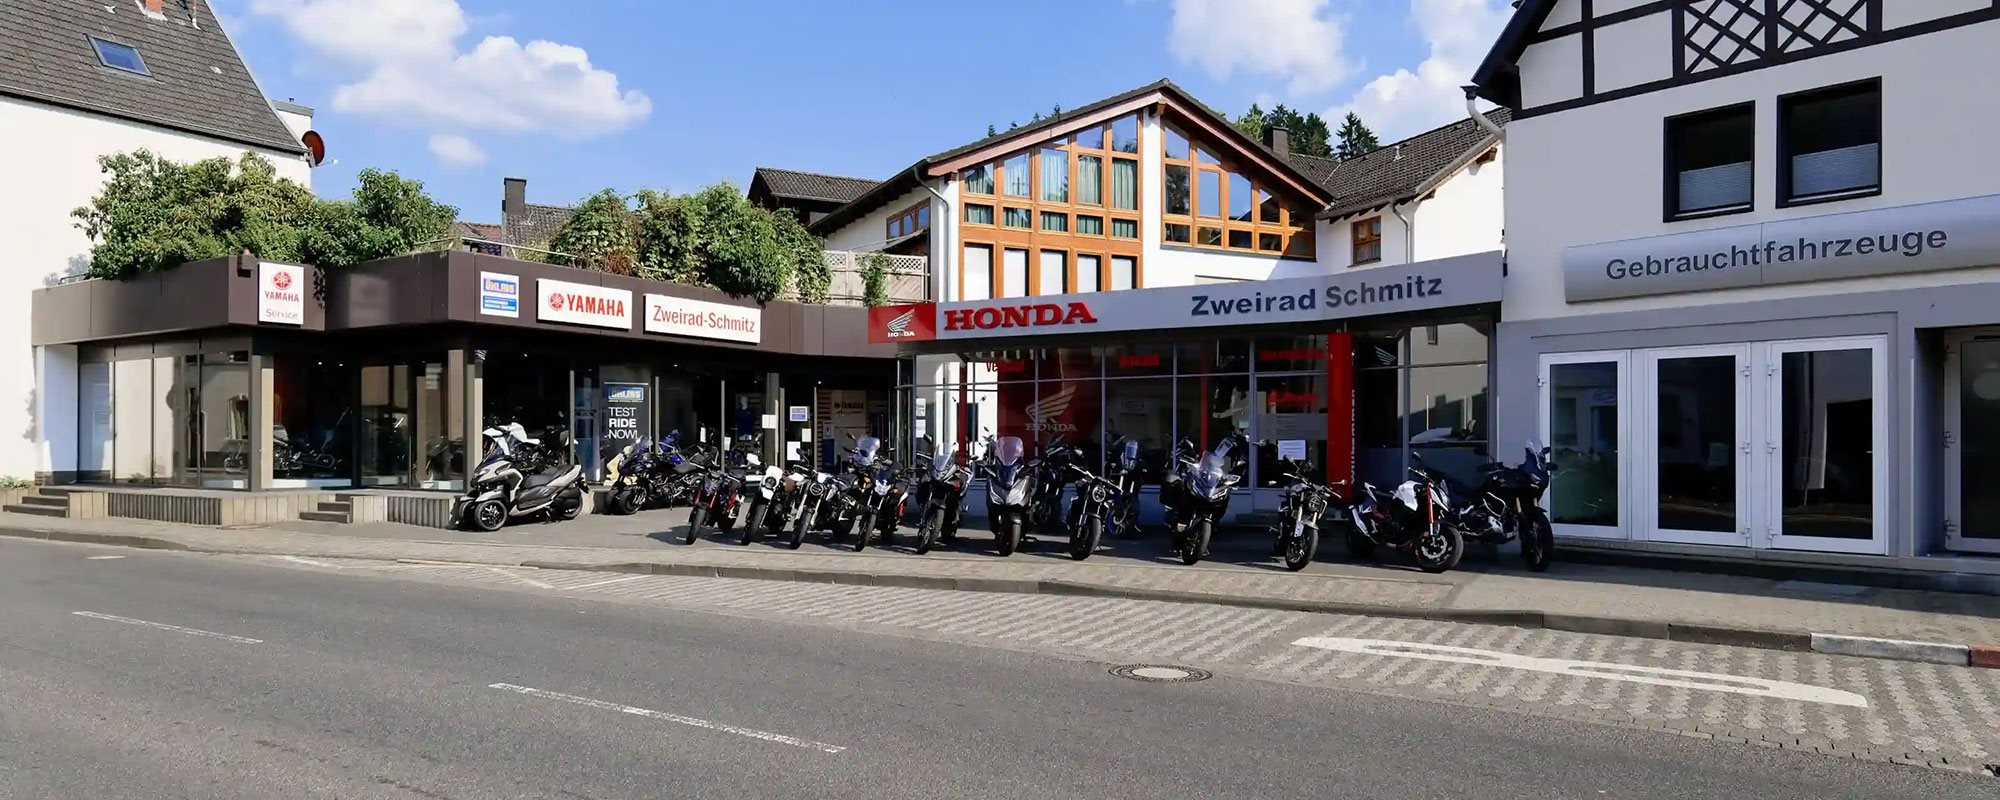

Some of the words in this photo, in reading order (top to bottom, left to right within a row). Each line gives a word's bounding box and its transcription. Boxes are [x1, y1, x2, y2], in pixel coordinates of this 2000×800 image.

[1606, 229, 1947, 280] Gebrauchtfahrzeuge
[264, 290, 300, 303] YAMAHA
[1191, 289, 1316, 316] Zweirad
[1325, 275, 1442, 308] Schmitz
[265, 308, 299, 319] Service
[567, 294, 625, 318] YAMAHA
[653, 305, 756, 333] Zweirad-Schmitz
[943, 302, 1098, 331] HONDA
[608, 407, 637, 417] TEST
[608, 418, 637, 428] RIDE
[1025, 423, 1079, 432] HONDA
